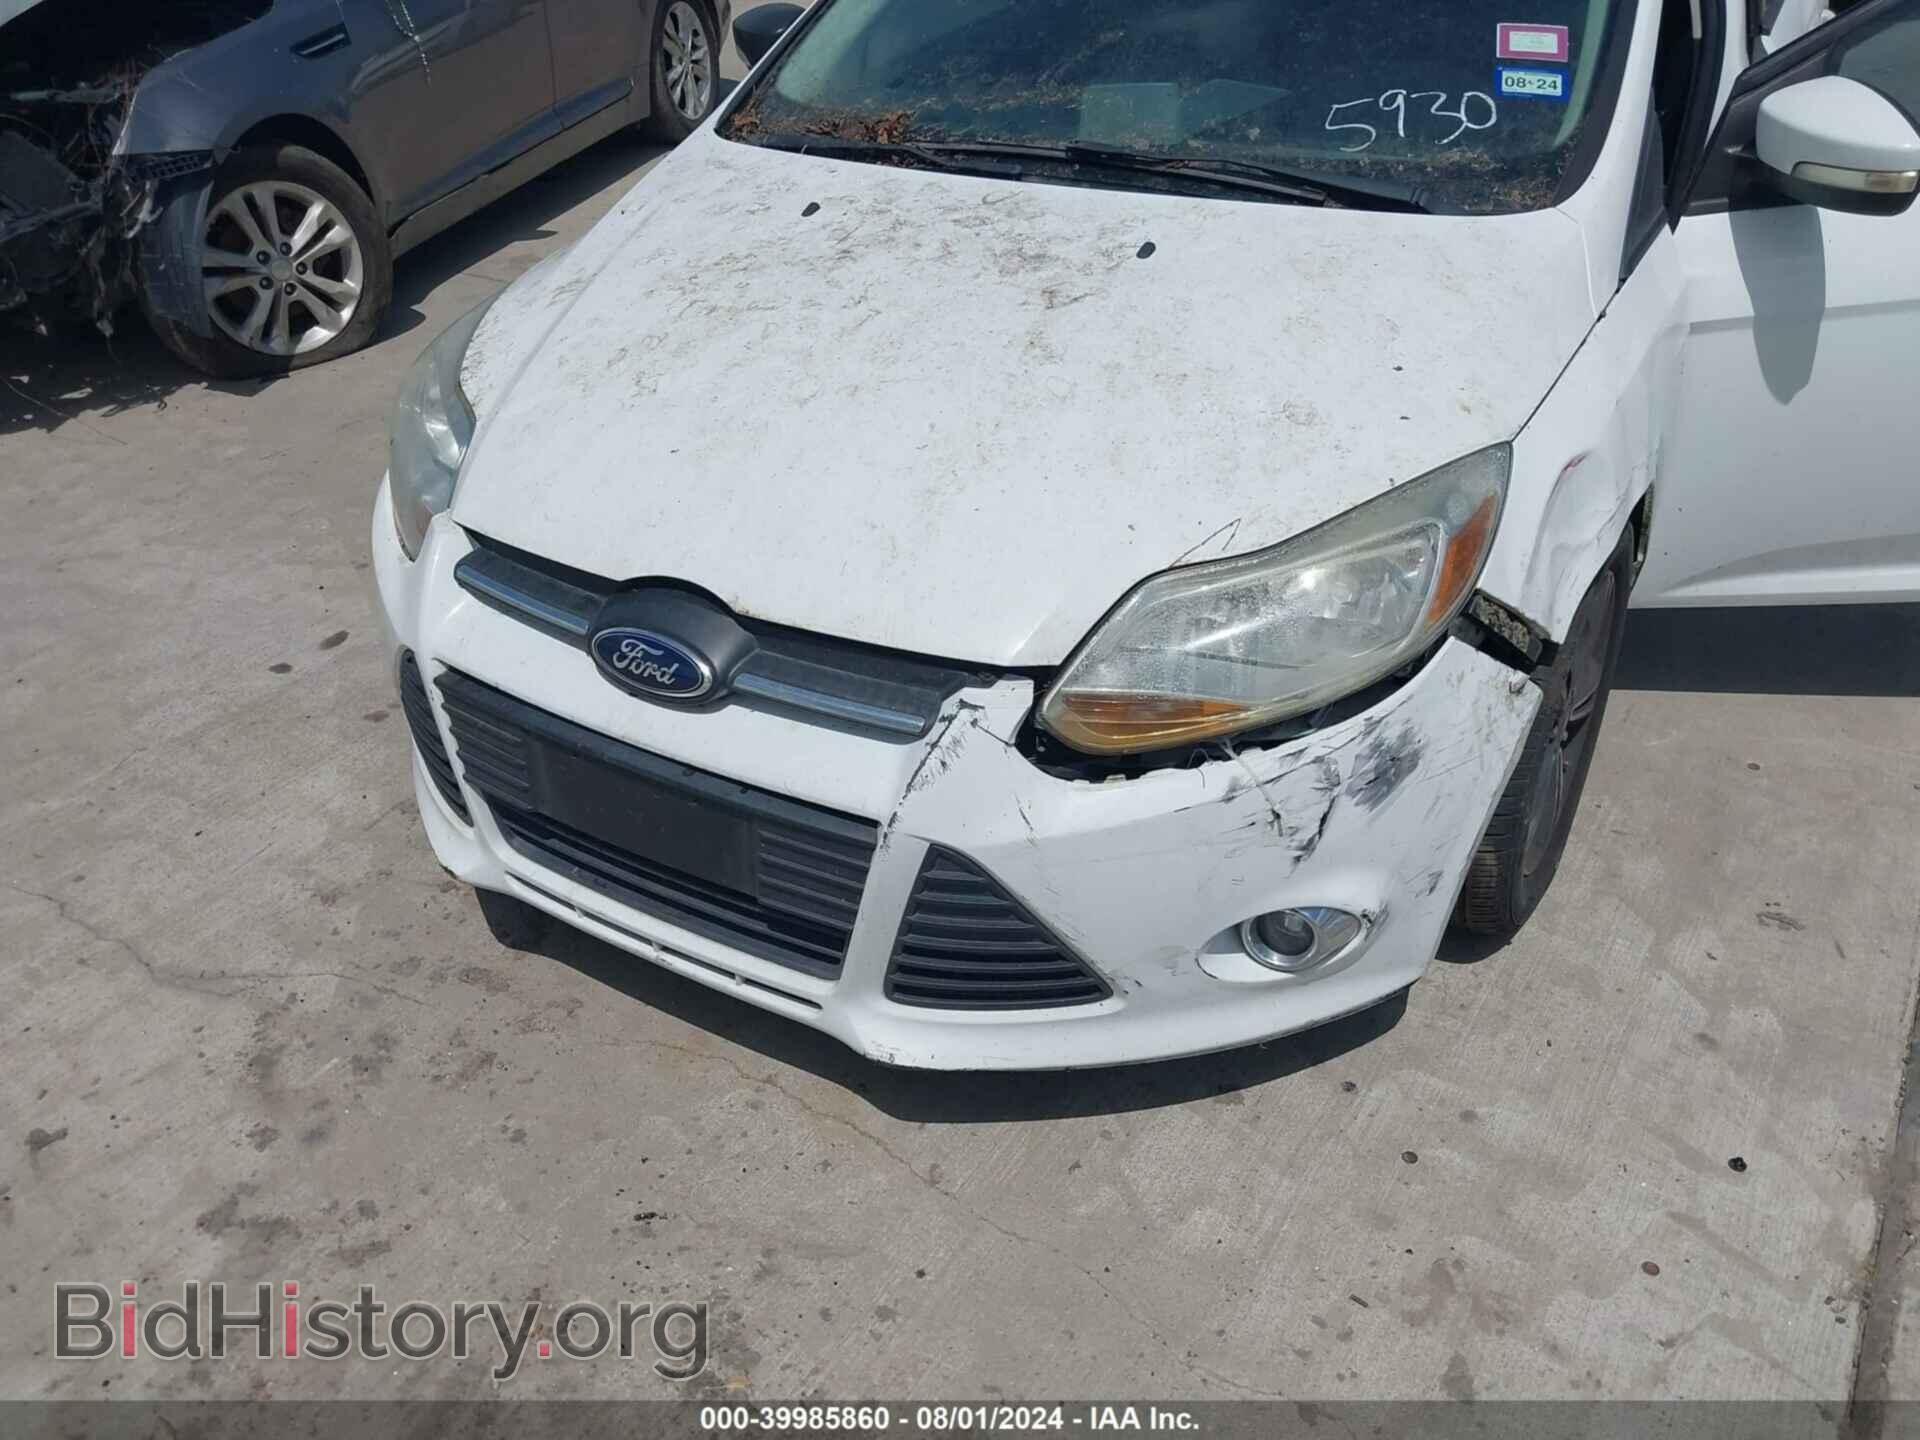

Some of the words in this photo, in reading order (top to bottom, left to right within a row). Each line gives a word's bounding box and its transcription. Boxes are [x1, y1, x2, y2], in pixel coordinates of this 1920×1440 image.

[1504, 76, 1527, 89] 08
[1536, 78, 1558, 91] 24
[1324, 89, 1497, 152] 5930
[612, 638, 680, 685] Ford
